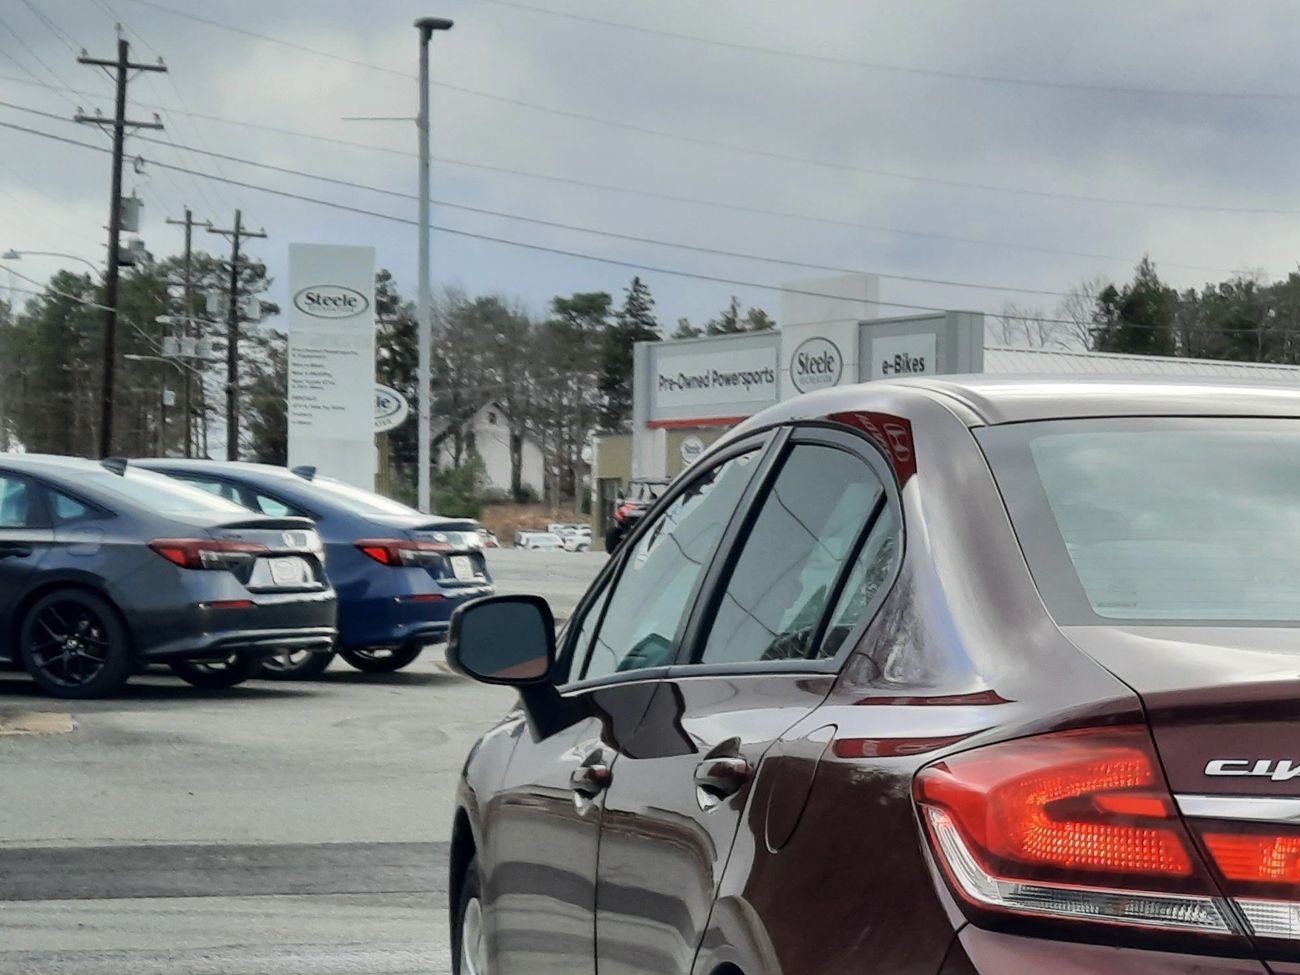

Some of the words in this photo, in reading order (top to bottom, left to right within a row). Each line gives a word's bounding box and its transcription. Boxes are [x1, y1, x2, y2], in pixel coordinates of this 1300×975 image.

[304, 291, 358, 308] Steele
[797, 351, 835, 376] Steele
[882, 352, 925, 375] e-Bikes
[658, 369, 710, 391] Pre-Owned
[712, 367, 774, 391] Powersports
